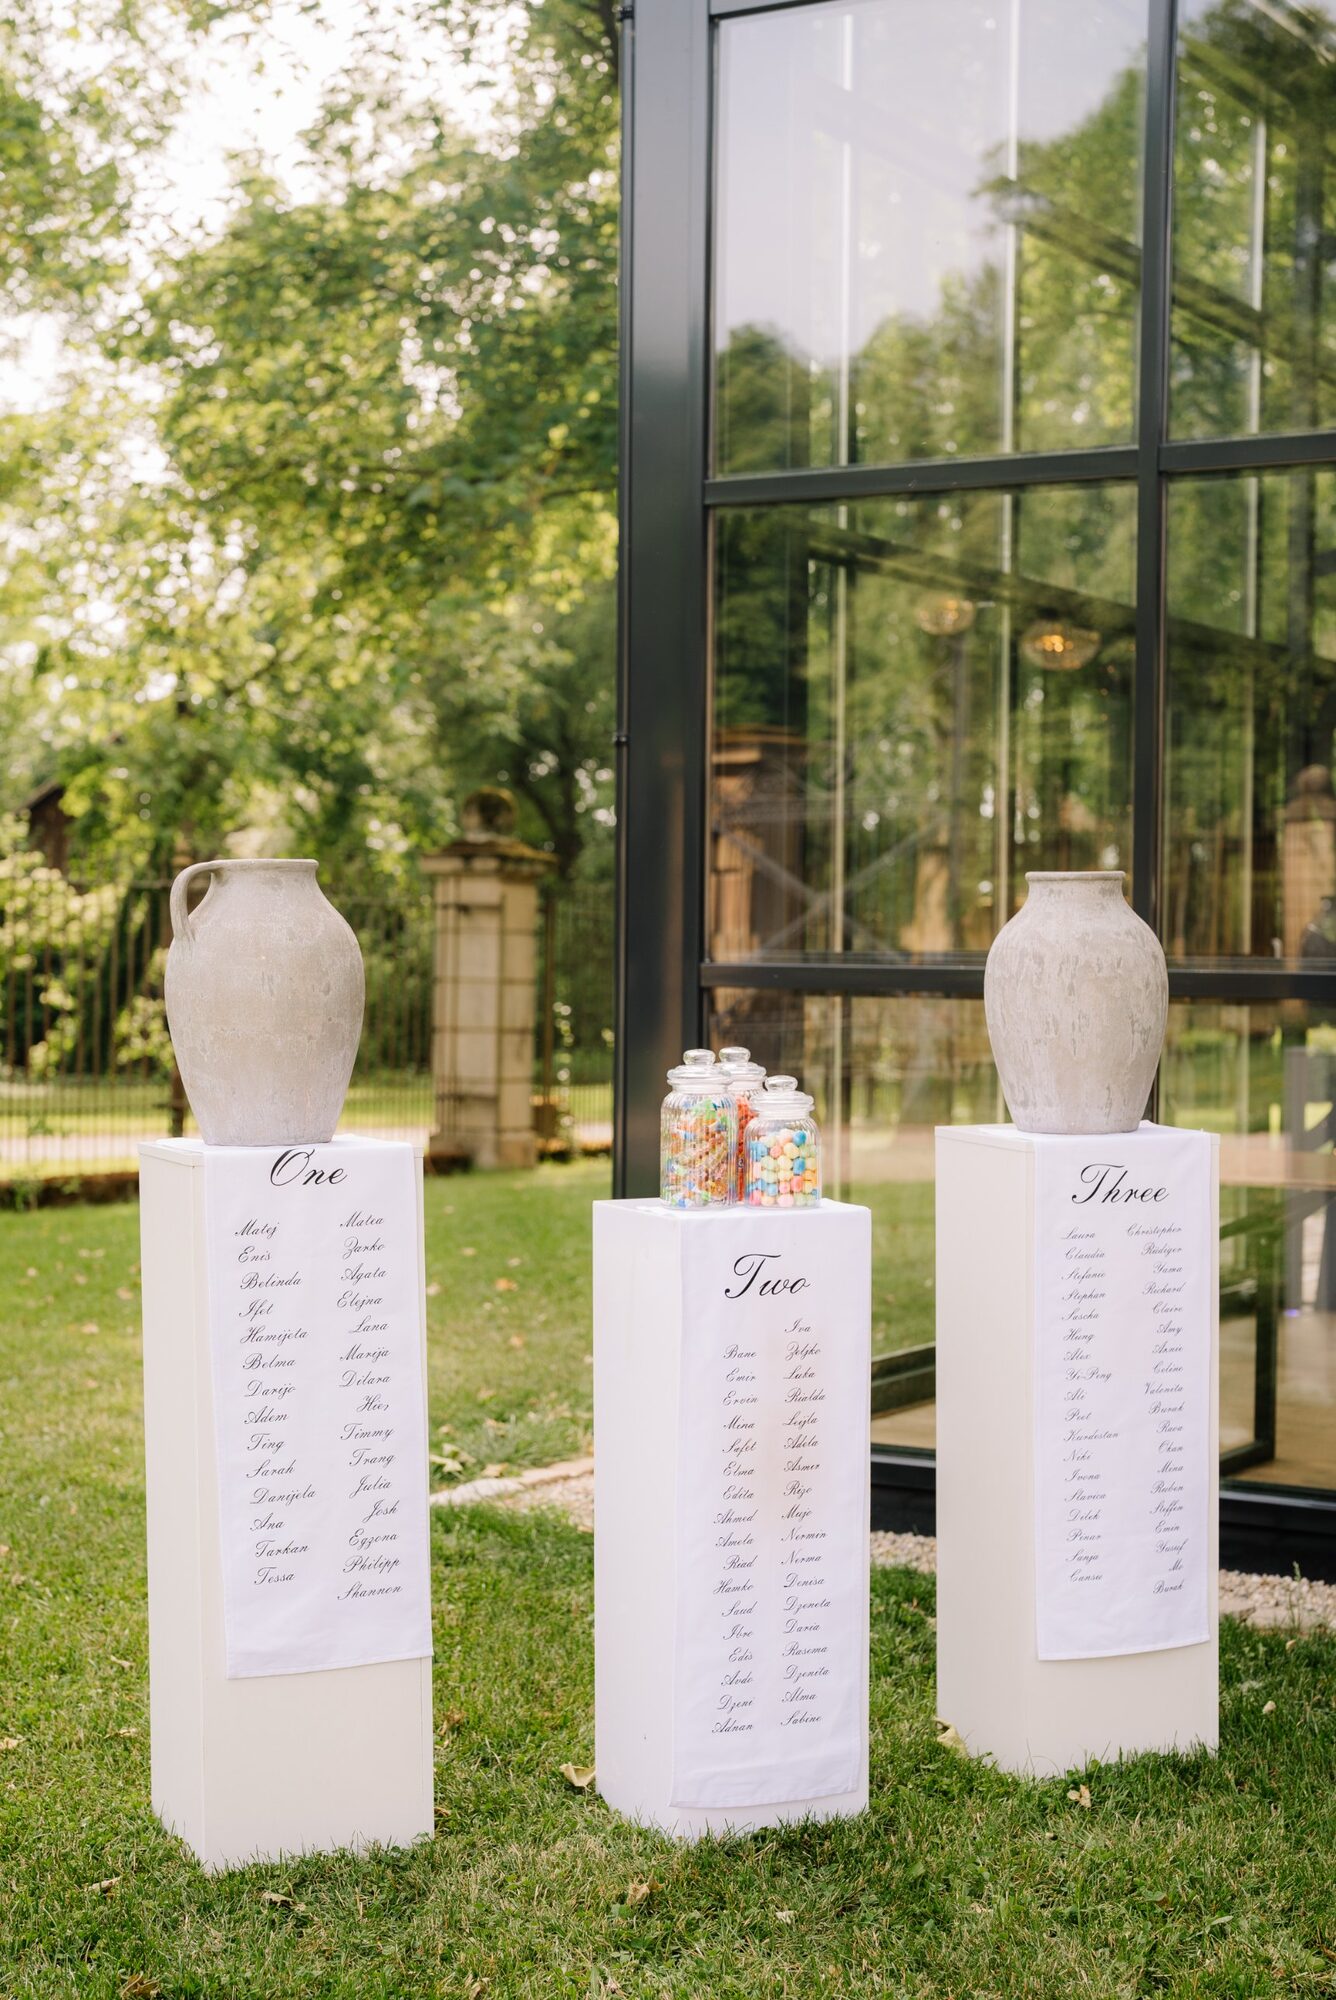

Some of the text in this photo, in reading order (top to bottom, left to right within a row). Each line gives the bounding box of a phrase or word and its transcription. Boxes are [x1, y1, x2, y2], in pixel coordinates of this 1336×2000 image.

[270, 1149, 347, 1186] One
[1072, 1164, 1169, 1204] Three
[340, 1211, 384, 1227] Matea
[234, 1219, 279, 1239] Matej
[1061, 1228, 1095, 1239] Laura
[1127, 1223, 1182, 1239] Christopher
[238, 1246, 271, 1263] Enis
[342, 1236, 385, 1260] Zarko
[1065, 1247, 1105, 1260] Claudia
[1141, 1242, 1182, 1258] Rüdiger
[240, 1271, 302, 1289] Belinda
[341, 1263, 387, 1286] Agata
[725, 1254, 810, 1299] Two
[1062, 1267, 1105, 1284] Stefanie
[1062, 1289, 1106, 1304] Stephan
[1144, 1282, 1185, 1295] Richard
[239, 1299, 273, 1322] Ifet
[1062, 1308, 1099, 1320] Sascha
[1152, 1302, 1183, 1313] Claire
[349, 1315, 388, 1333] Lana
[784, 1318, 811, 1333] Iva
[1157, 1320, 1183, 1336] Amy
[1063, 1328, 1094, 1343] Hung
[340, 1344, 390, 1362] Marija
[723, 1344, 757, 1359] Bane
[785, 1341, 821, 1361] Zeljko
[1064, 1348, 1091, 1361] Alex
[243, 1353, 296, 1370] Belma
[1154, 1361, 1183, 1374] Celine
[339, 1370, 391, 1387] Dilara
[726, 1368, 755, 1382] Emir
[783, 1365, 816, 1379] Luka
[723, 1391, 758, 1406] Ervin
[785, 1387, 826, 1403] Rialda
[1064, 1389, 1087, 1401] Ali
[244, 1406, 288, 1424] Adem
[1148, 1401, 1185, 1414] Burak
[723, 1415, 755, 1429] Mina
[340, 1423, 393, 1441] Timmy
[247, 1433, 285, 1454] Ting
[722, 1438, 757, 1457] Safet
[784, 1434, 819, 1449] Adela
[1158, 1441, 1183, 1452] Okan
[349, 1448, 395, 1468] Trang
[246, 1459, 296, 1478] Sarah
[723, 1461, 755, 1476] Elma
[1065, 1469, 1100, 1481] Ivona
[1157, 1461, 1183, 1473] Mina
[349, 1474, 392, 1499] Julia
[723, 1485, 754, 1500] Edita
[1150, 1481, 1184, 1494] Ruben
[250, 1484, 316, 1506] Danijela
[362, 1499, 400, 1523] Josh
[713, 1509, 758, 1524] Ahmed
[1067, 1509, 1100, 1521] Dilek
[250, 1513, 285, 1531] Ana
[1155, 1520, 1180, 1533] Emin
[349, 1528, 399, 1550] Egzona
[715, 1532, 754, 1547] Amela
[781, 1527, 826, 1542] Nermin
[1066, 1529, 1101, 1541] Pinar
[255, 1540, 310, 1558] Tarkan
[1156, 1539, 1189, 1554] Yusuf
[343, 1555, 400, 1574] Philipp
[723, 1555, 758, 1570] Riad
[1065, 1549, 1099, 1565] Sanja
[254, 1567, 295, 1585] Tessa
[784, 1573, 825, 1588] Denisa
[337, 1582, 403, 1600] Shannon
[713, 1579, 754, 1595] Hamko
[1153, 1580, 1184, 1594] Burak
[722, 1601, 758, 1617] Saud
[783, 1619, 821, 1634] Daria
[729, 1648, 752, 1662] Edis
[782, 1687, 817, 1703] Alma
[712, 1718, 753, 1733] Adnan
[780, 1711, 822, 1726] Sabine
